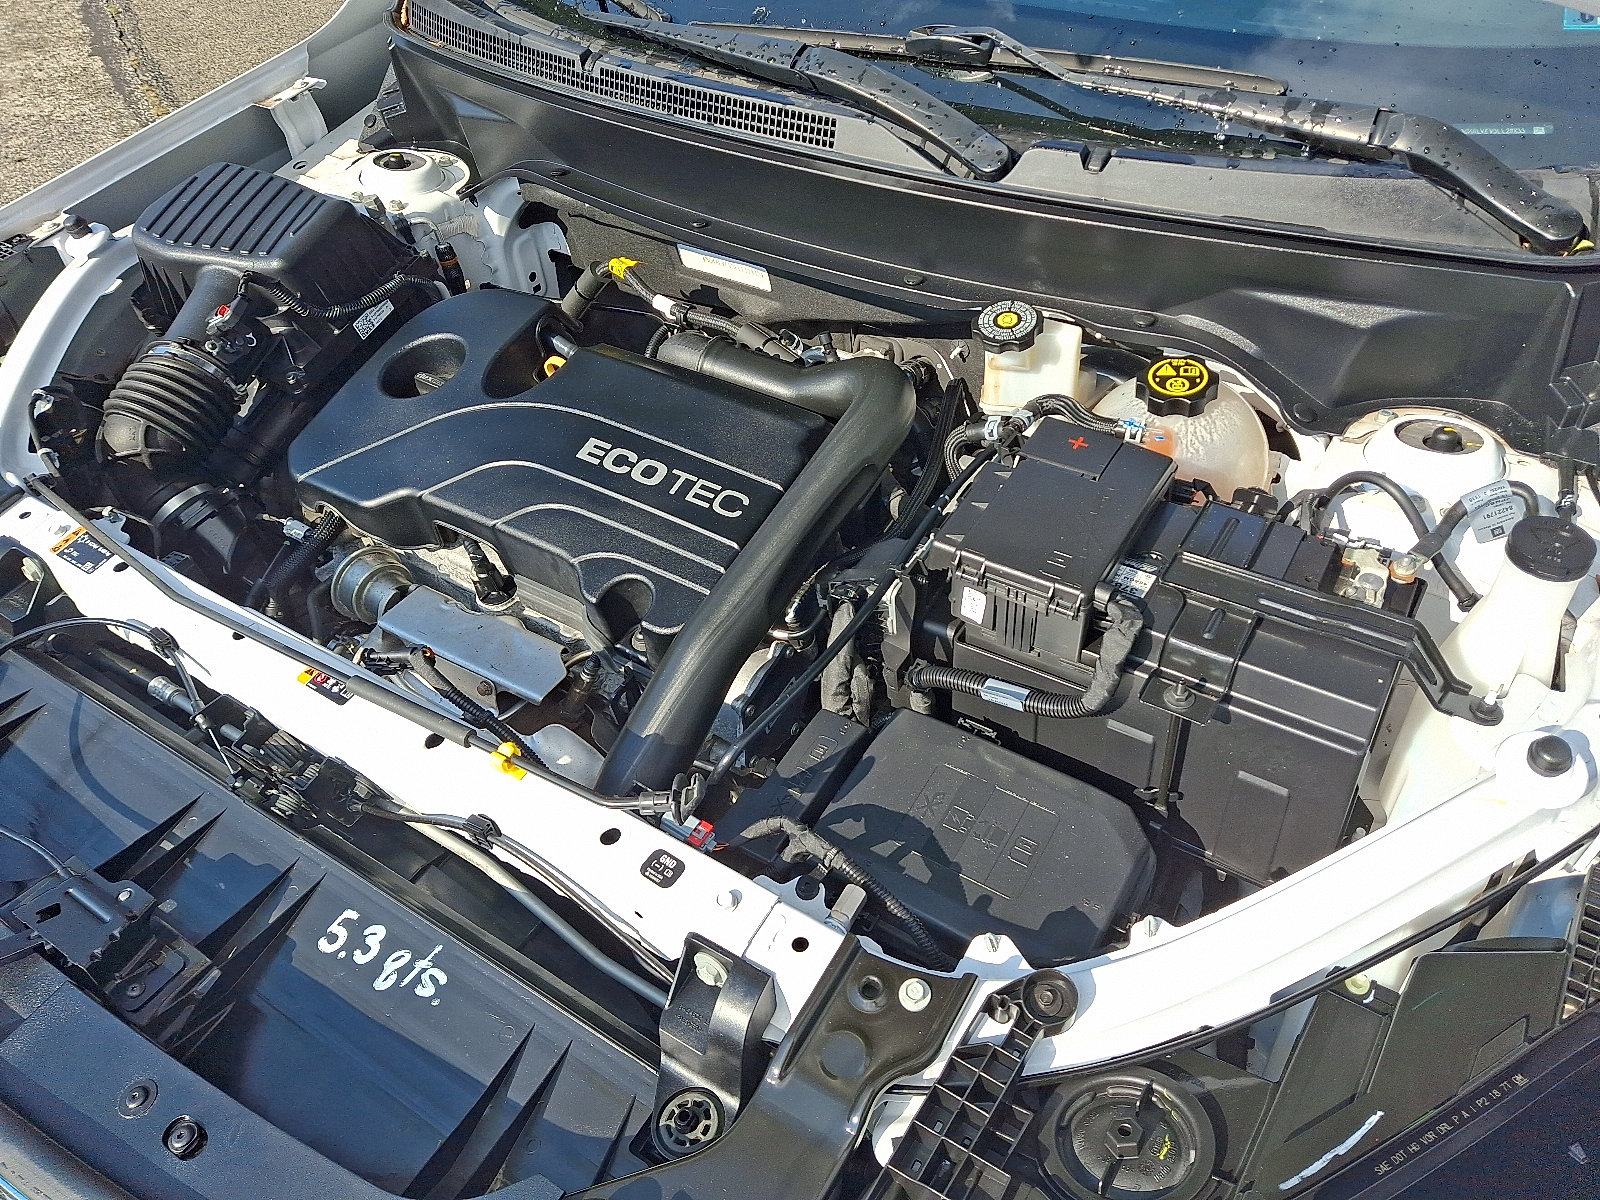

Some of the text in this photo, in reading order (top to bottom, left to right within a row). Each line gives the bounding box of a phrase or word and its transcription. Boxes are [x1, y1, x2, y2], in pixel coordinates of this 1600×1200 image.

[576, 437, 750, 518] ECOTEC
[660, 854, 678, 869] GND
[317, 908, 387, 965] 5.3
[1375, 1160, 1392, 1175] SAE
[1391, 1149, 1408, 1165] DOT
[1436, 1122, 1454, 1135] DRL
[1452, 1115, 1460, 1124] P
[1461, 1110, 1470, 1119] A
[1475, 1096, 1490, 1108] P2
[1489, 1089, 1502, 1100] 18
[1499, 1081, 1512, 1092] 7T
[1511, 1073, 1529, 1087] GM
